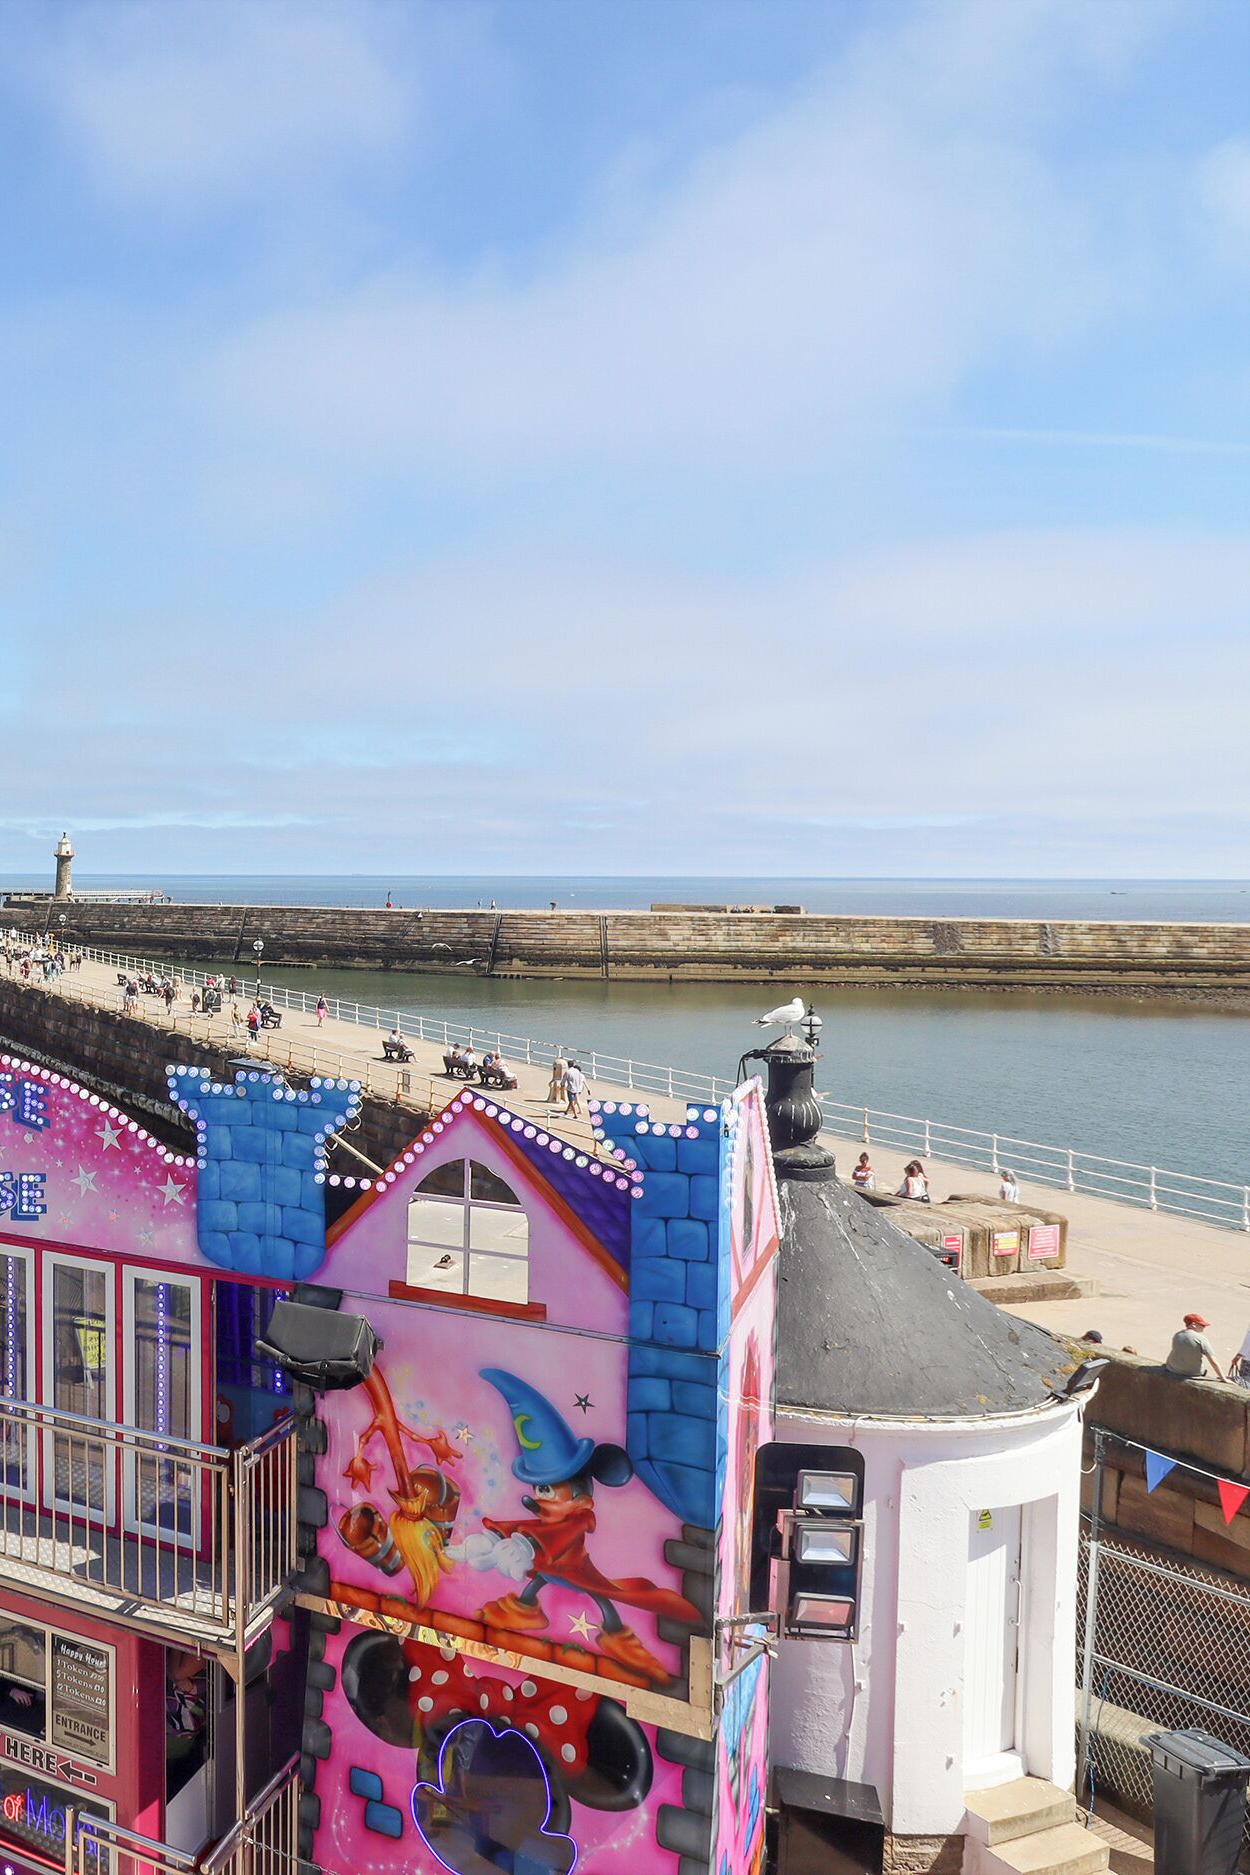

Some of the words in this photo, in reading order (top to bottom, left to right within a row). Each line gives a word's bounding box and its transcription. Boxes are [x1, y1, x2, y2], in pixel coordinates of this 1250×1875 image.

[60, 1643, 84, 1662] Happy
[61, 1660, 89, 1676] Token
[56, 1669, 61, 1679] 5
[61, 1671, 93, 1690] Tokens
[63, 1684, 95, 1702] Tokens
[55, 1714, 106, 1743] ENTRANCE
[5, 1734, 58, 1775] HERE
